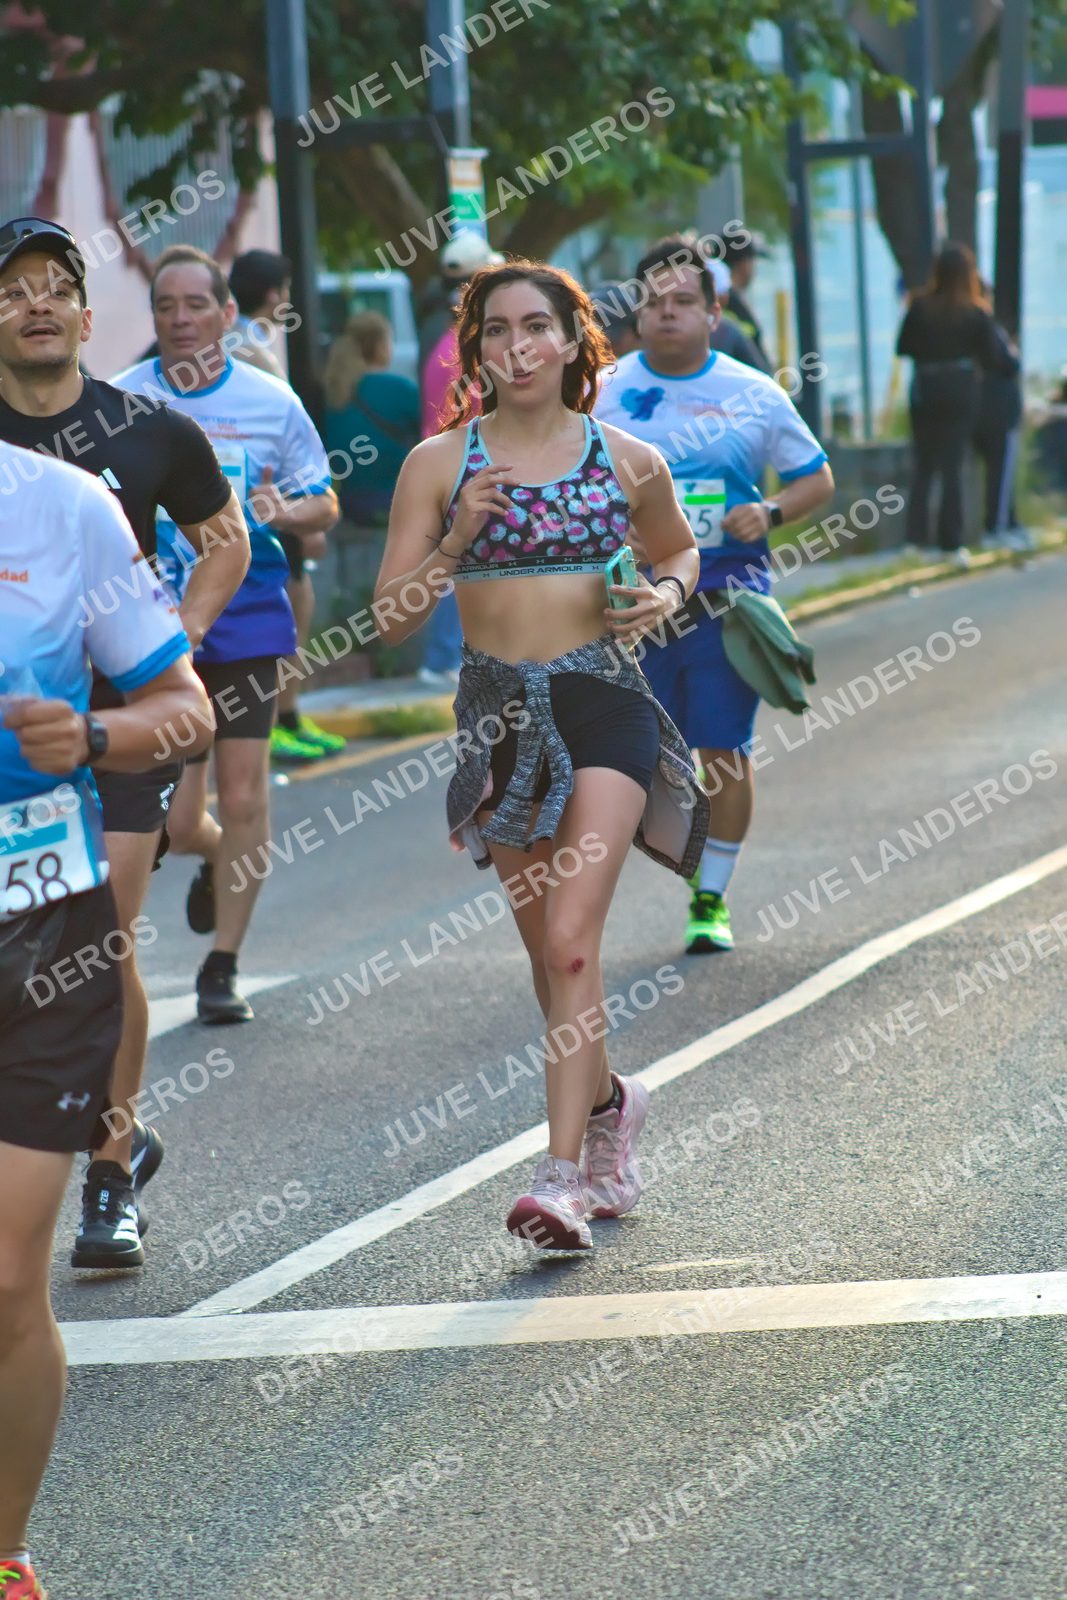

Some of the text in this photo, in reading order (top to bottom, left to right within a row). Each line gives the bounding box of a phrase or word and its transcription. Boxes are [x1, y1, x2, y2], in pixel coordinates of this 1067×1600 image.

[499, 565, 583, 577] UNDER ARMOUR
[5, 851, 71, 915] 58
